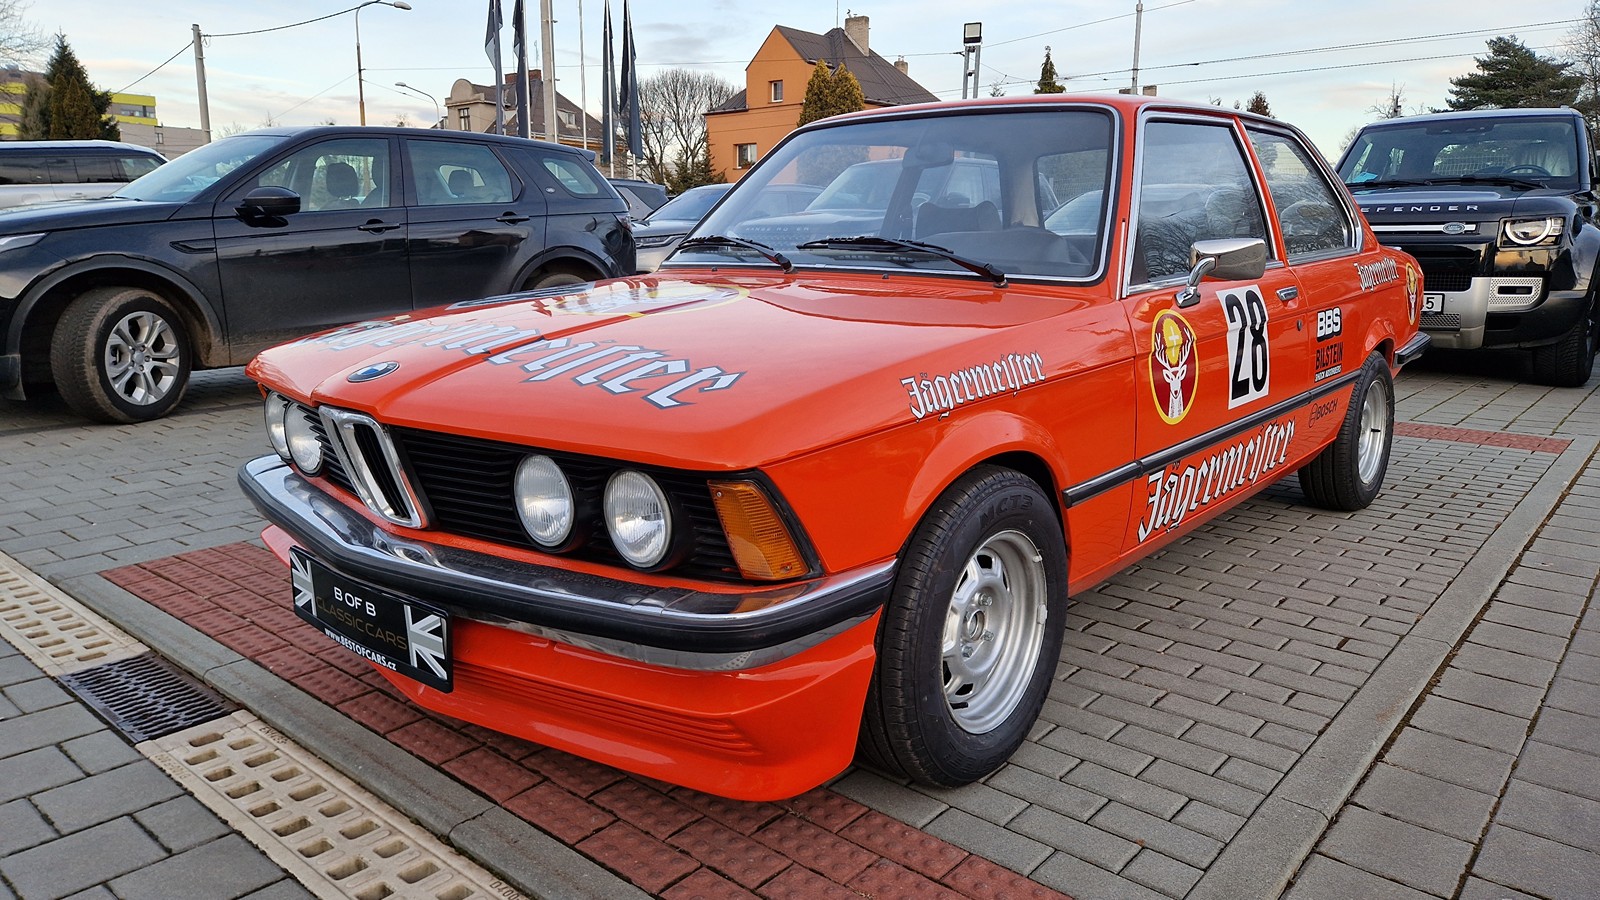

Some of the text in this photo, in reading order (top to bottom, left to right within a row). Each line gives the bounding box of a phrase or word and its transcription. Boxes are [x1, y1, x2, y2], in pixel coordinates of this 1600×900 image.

[1361, 205, 1478, 213] EFENDER
[1317, 307, 1341, 341] BBS
[1225, 289, 1267, 400] 28
[1315, 342, 1343, 370] BILSTEIN
[900, 351, 1046, 422] Jägermeister
[1316, 398, 1338, 420] BOSCH
[1137, 417, 1295, 542] Jägermeister
[334, 586, 376, 616] B OF B
[316, 596, 407, 650] CLASSIC CARS
